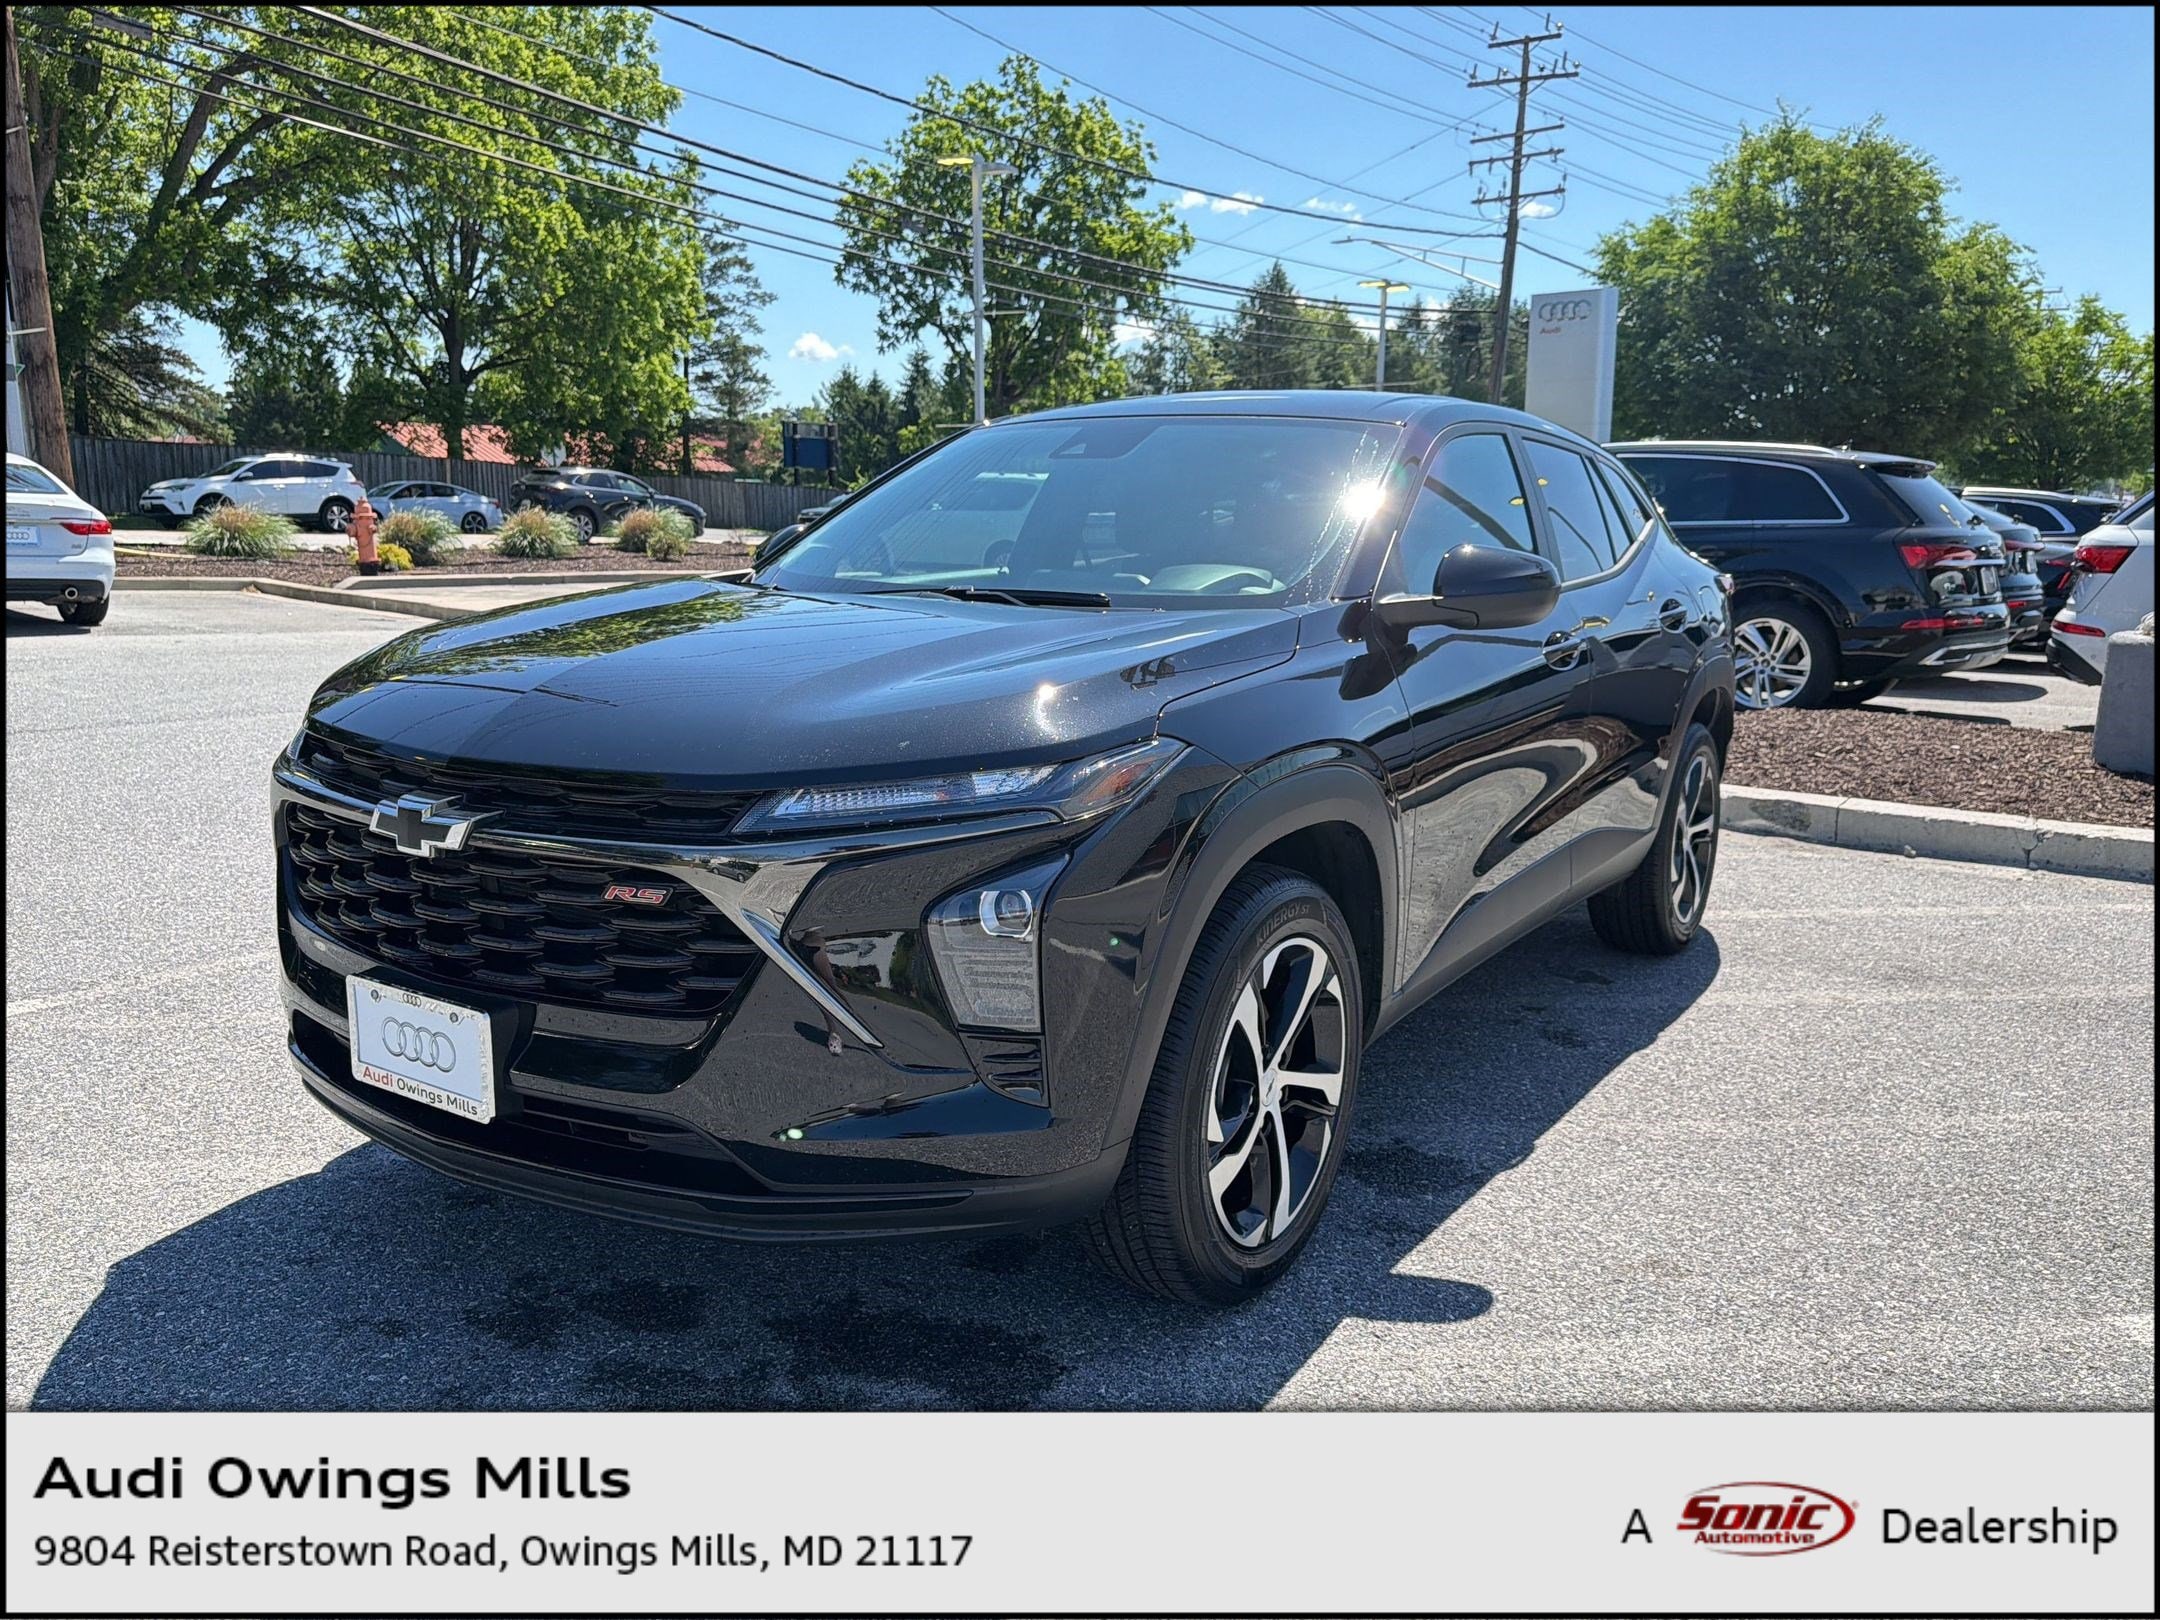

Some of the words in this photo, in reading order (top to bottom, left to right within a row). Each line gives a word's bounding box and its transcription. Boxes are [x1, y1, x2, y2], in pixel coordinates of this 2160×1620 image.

[604, 885, 667, 904] RS
[362, 1066, 393, 1088] Audi
[396, 1077, 443, 1104] Owings
[446, 1093, 478, 1116] Mills
